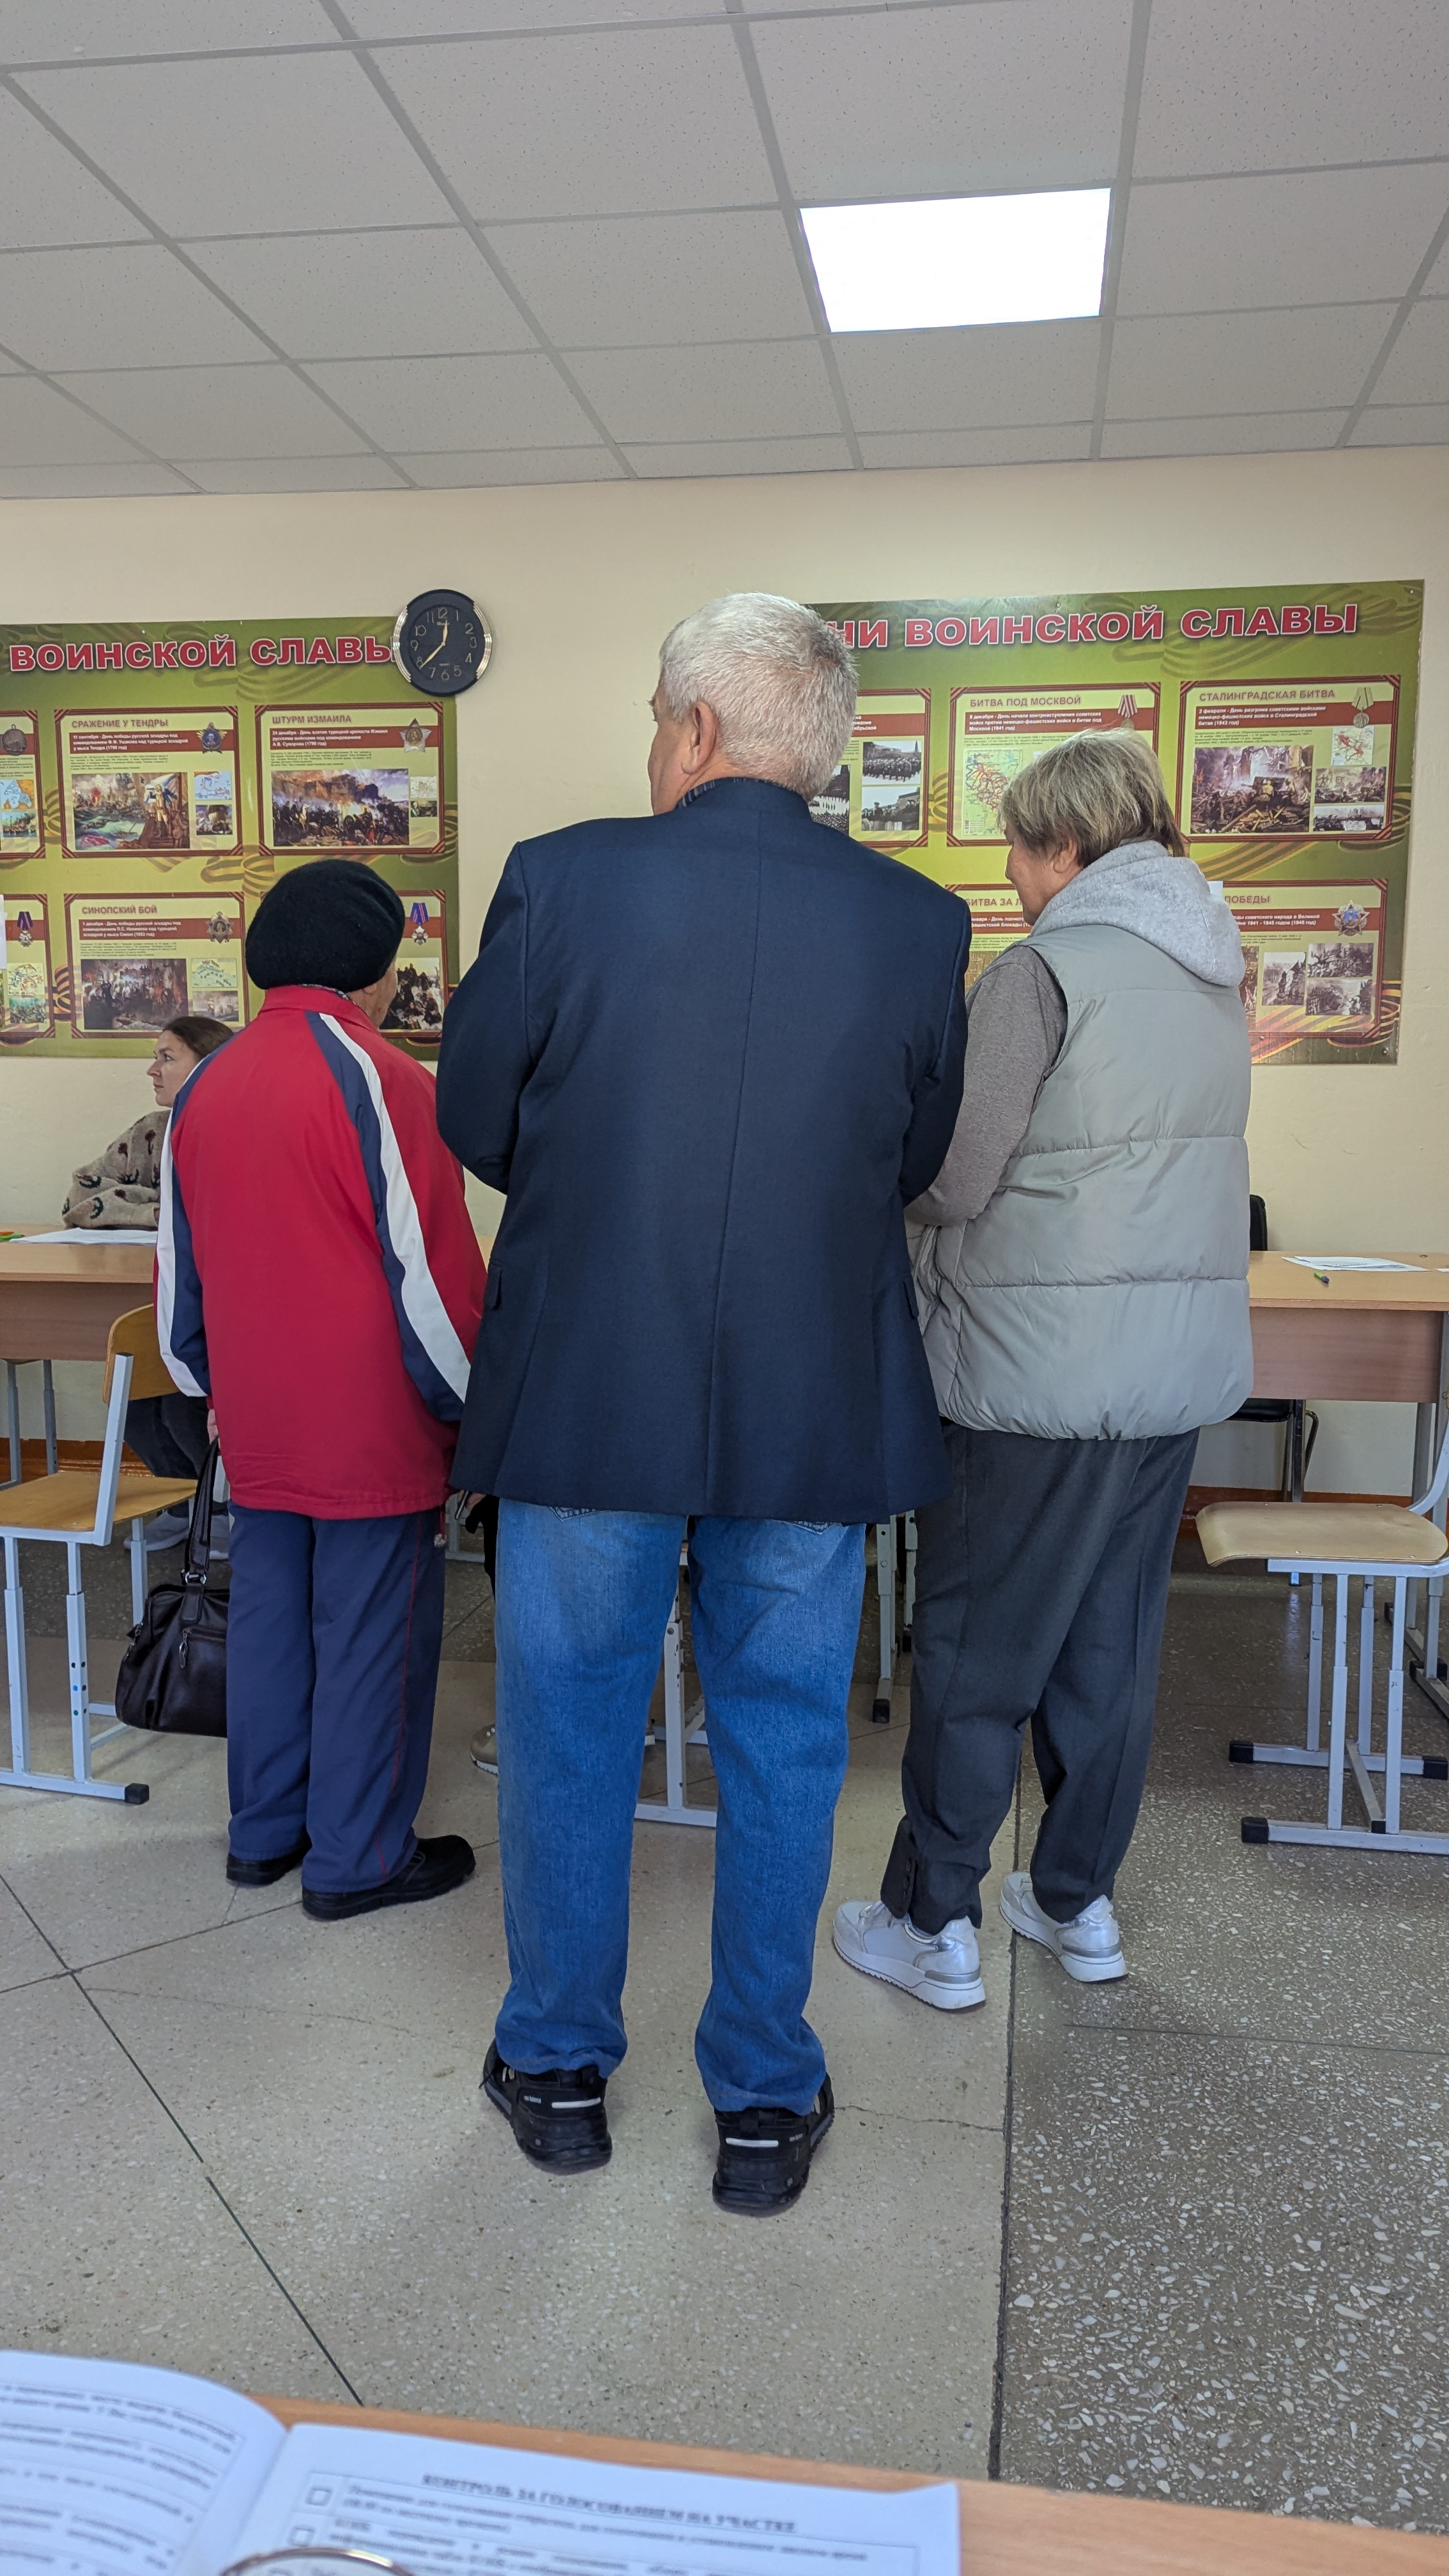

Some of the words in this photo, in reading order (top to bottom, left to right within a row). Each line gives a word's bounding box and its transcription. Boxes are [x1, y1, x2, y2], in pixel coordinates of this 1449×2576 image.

[427, 610, 434, 623] 11
[438, 607, 447, 618] 12
[415, 625, 426, 636] 10
[465, 623, 473, 634] 2
[826, 620, 888, 648] НИ
[905, 604, 1164, 647] ВОИНСКОЙ
[1180, 604, 1358, 638] СЛАВЫ
[410, 640, 418, 652] 9
[470, 636, 477, 648] 3
[10, 634, 236, 671] ВОИНСКОЙ
[250, 636, 396, 665] СЛАВЫ
[465, 653, 471, 663] 4
[428, 667, 436, 678] 7
[441, 669, 449, 680] 6
[454, 665, 462, 677] 5
[970, 699, 1003, 707] БИТВА
[1006, 698, 1027, 707] ПОД
[1031, 695, 1081, 705] МОСКВОЙ
[1199, 691, 1296, 702] СТАЛИНГРАДСКАЯ
[1300, 689, 1335, 699] БИТВА
[72, 719, 120, 728] СРАЖЕНИЕ
[131, 719, 168, 728] ТЕНДРЫ
[272, 716, 305, 724] ШТУРМ
[307, 715, 351, 723] ИЗМАИЛА
[1225, 896, 1271, 904] ПОБЕДЫ
[82, 905, 136, 914] СИНОПСКИЙ
[139, 905, 157, 914] БОЙ
